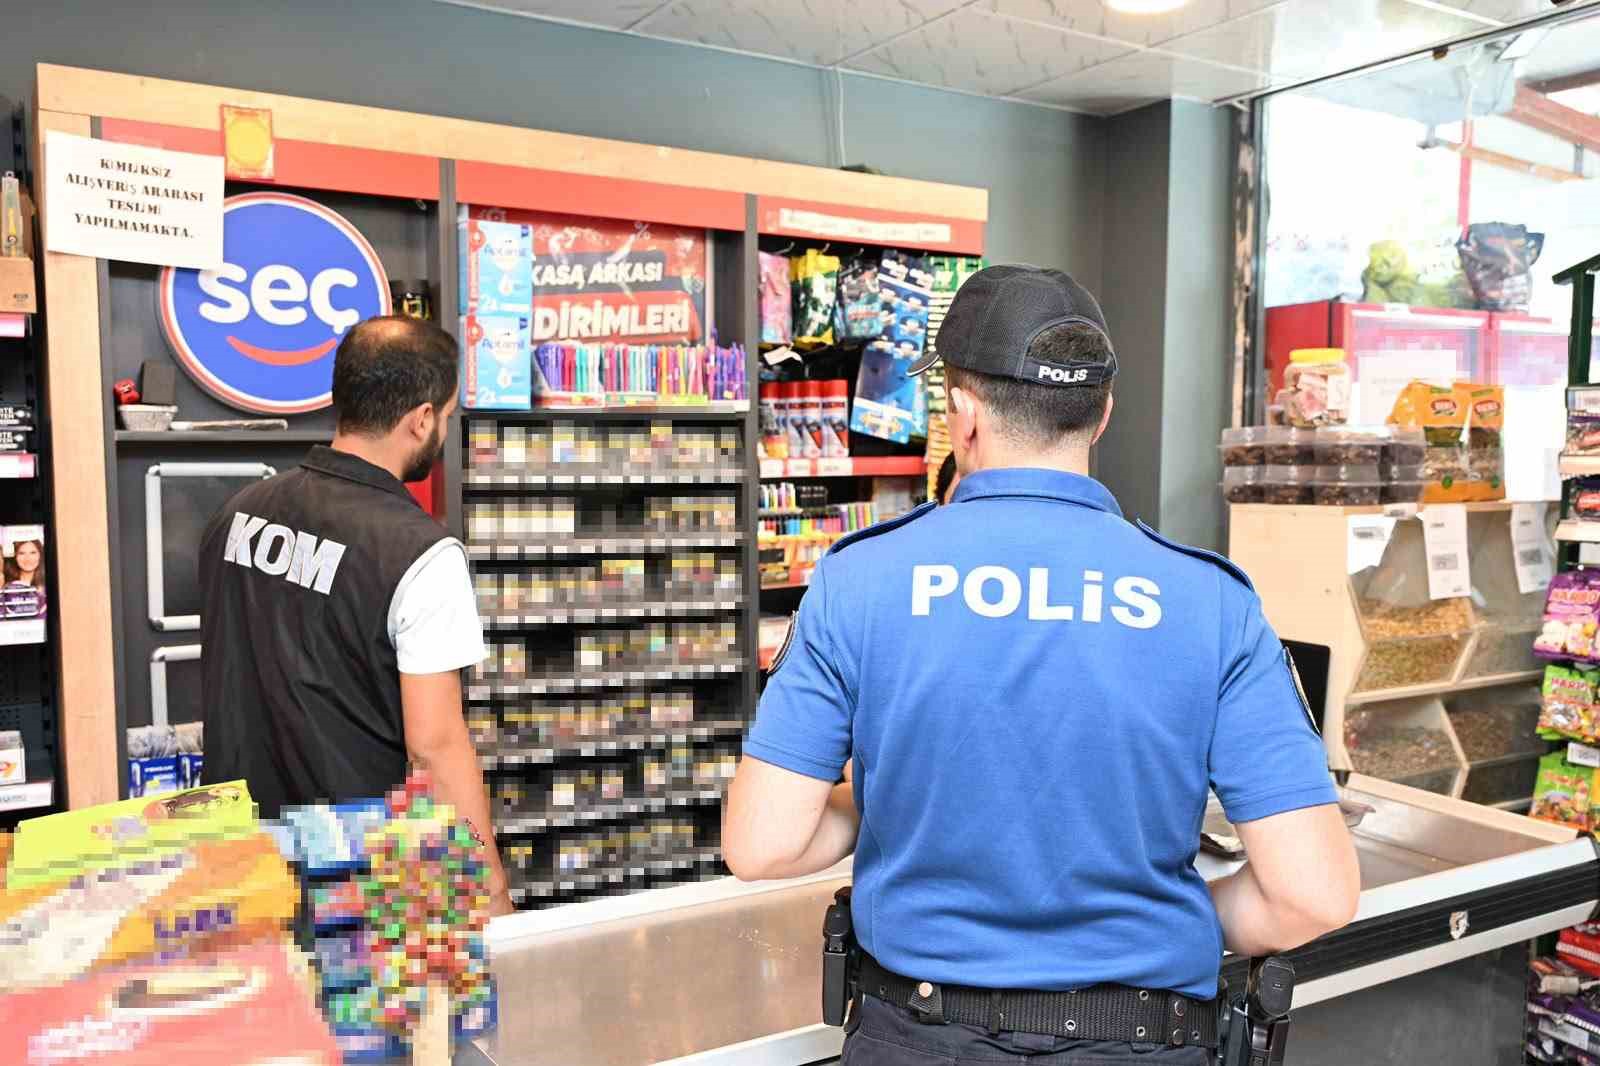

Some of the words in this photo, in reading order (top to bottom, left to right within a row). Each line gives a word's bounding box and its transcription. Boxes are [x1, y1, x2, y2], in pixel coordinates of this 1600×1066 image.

[198, 263, 360, 335] seç
[588, 261, 663, 284] ARKASI
[534, 299, 690, 340] DİRİMLERİ
[224, 511, 347, 595] KOM
